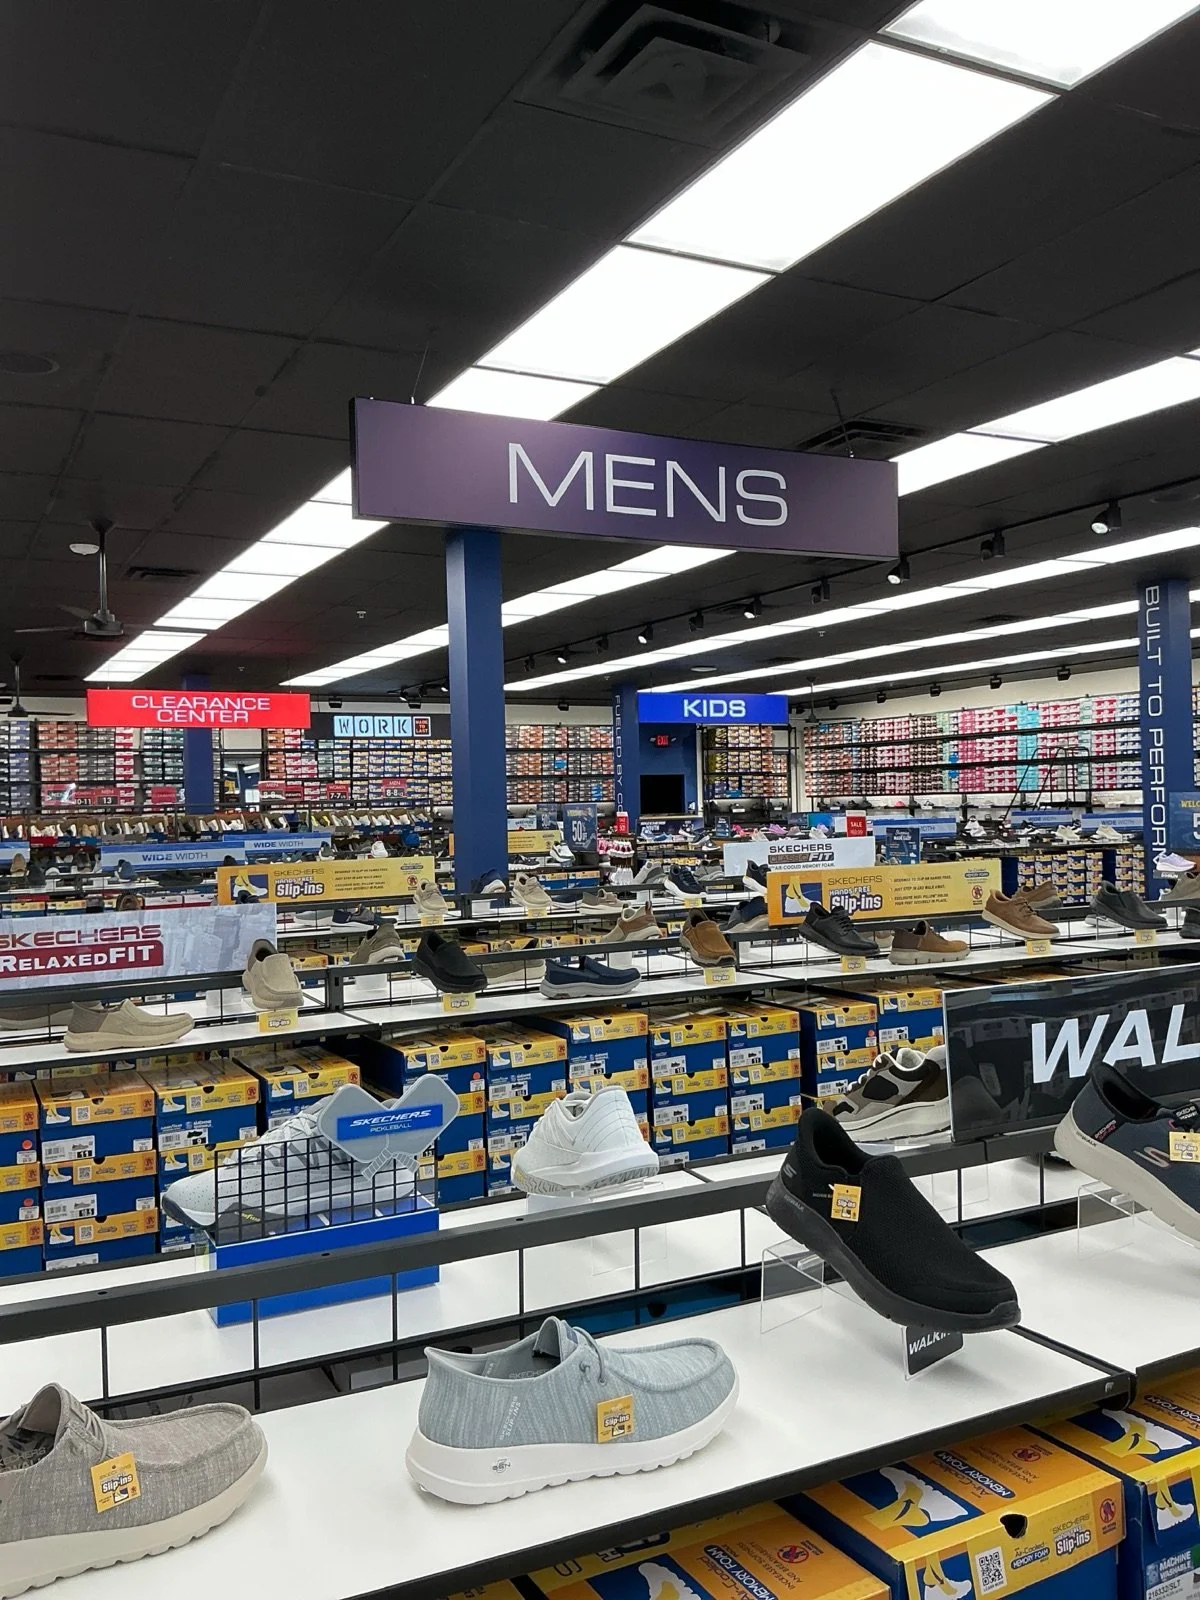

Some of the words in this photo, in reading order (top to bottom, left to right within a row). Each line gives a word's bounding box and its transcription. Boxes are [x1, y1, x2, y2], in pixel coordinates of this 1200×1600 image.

[508, 442, 788, 527] MENS
[1145, 585, 1162, 666] BUILT
[132, 695, 270, 710] CLEARANCE
[1147, 675, 1163, 717] TO
[157, 709, 249, 723] CENTER
[683, 699, 746, 718] KIDS
[338, 718, 407, 734] WORK
[614, 694, 622, 758] FUELED
[657, 735, 669, 746] EXIT
[616, 764, 623, 786] BY
[253, 841, 277, 849] WIDE
[278, 840, 304, 848] WIDTH
[769, 843, 833, 853] SKECHERS
[141, 852, 173, 862] WIDE
[174, 851, 209, 861] WIDTH
[808, 852, 833, 861] FIT
[273, 868, 325, 877] SKECHERS
[827, 875, 883, 886] SKECHERS
[275, 882, 324, 898] Slip-ins
[829, 887, 852, 896] HANDS
[854, 885, 871, 893] FREE
[831, 894, 882, 912] Slip-ins
[1031, 1003, 1200, 1084] WAL
[350, 1109, 432, 1127] SKECHERS
[370, 1122, 412, 1132] PICKLEBALL
[603, 1413, 631, 1427] Slip-ins
[937, 1451, 969, 1471] FOAM
[101, 1473, 134, 1494] Slip-ins
[965, 1467, 1012, 1497] MEMORY
[1052, 1513, 1090, 1535] SKECHERS
[1014, 1541, 1046, 1558] Air-Cooled
[1055, 1530, 1092, 1556] Slip-ins
[707, 1546, 737, 1570] FOAM
[1012, 1554, 1034, 1569] MEMORY
[1034, 1548, 1050, 1560] FOAM
[1160, 1550, 1192, 1571] MACHINE
[762, 1563, 796, 1591] INCREASES
[786, 1571, 805, 1584] AND
[1160, 1560, 1191, 1580] WASHABLE
[731, 1569, 776, 1600] MEMORY
